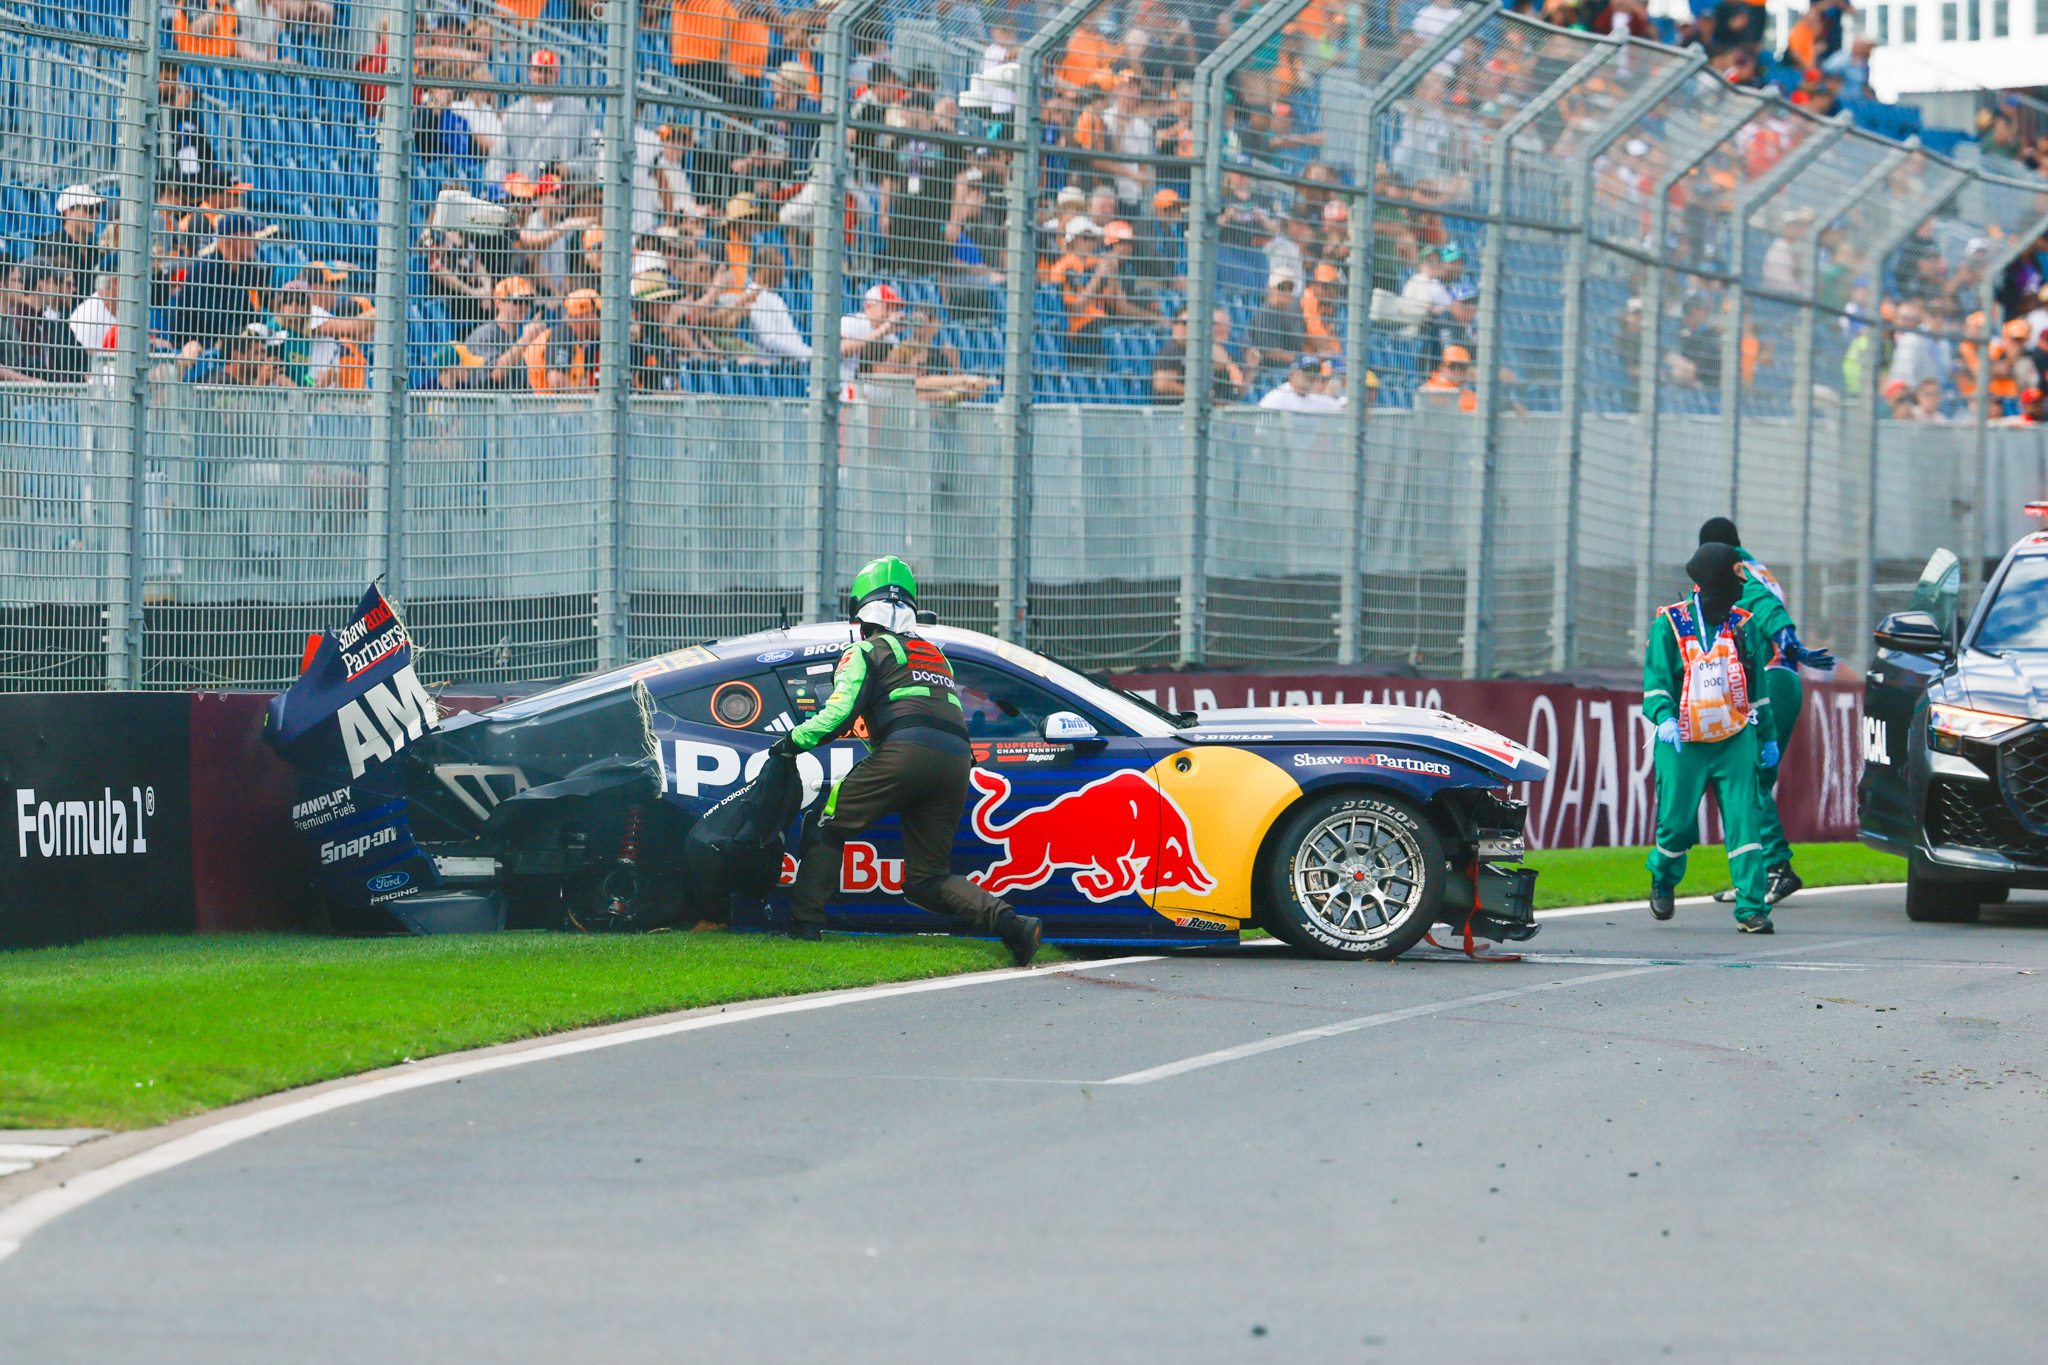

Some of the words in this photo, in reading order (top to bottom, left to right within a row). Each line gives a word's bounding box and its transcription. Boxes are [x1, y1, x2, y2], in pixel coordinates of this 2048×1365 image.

[341, 623, 406, 679] Partners
[762, 649, 789, 662] Ford
[911, 670, 957, 692] DOCTOR
[337, 664, 441, 780] AM
[1025, 753, 1055, 763] Repco
[300, 786, 352, 817] AMPLIFY
[703, 803, 720, 819] new
[16, 786, 128, 858] Formula
[294, 813, 333, 831] Premium
[333, 802, 356, 820] Fuels
[1342, 799, 1419, 831] DUNLOP
[320, 826, 398, 865] Snap-on
[373, 873, 404, 890] Ford
[370, 886, 419, 905] RACING
[1187, 916, 1228, 931] Repco
[1300, 920, 1343, 949] MAXX
[1340, 938, 1389, 953] SPORT
